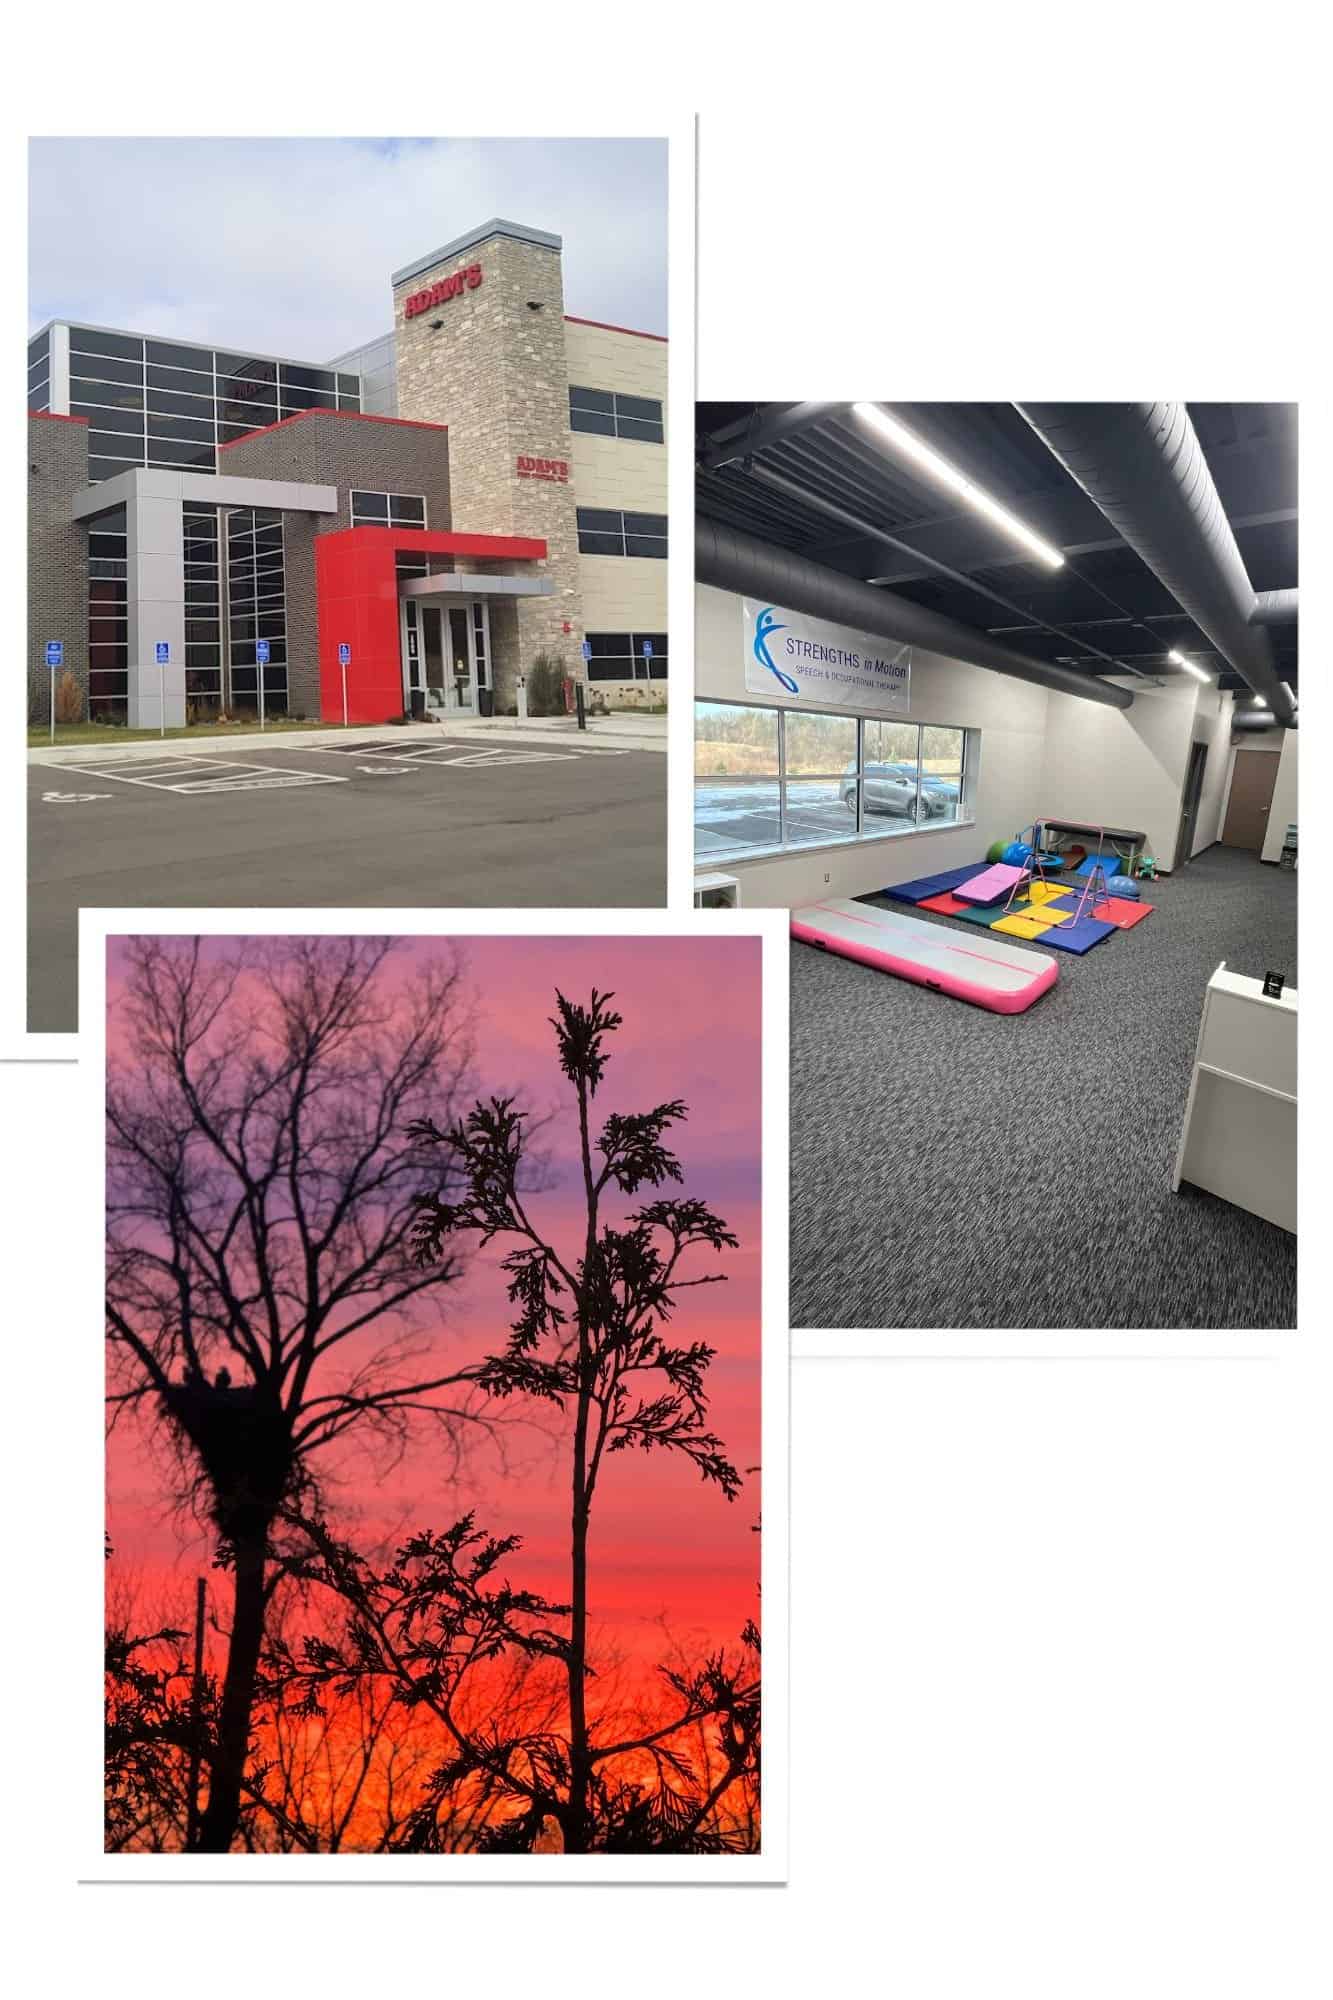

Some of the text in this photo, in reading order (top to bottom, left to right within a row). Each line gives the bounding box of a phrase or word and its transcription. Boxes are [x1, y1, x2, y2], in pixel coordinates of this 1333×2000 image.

[405, 263, 483, 319] ADAM'S
[517, 456, 568, 475] ADAM'S
[786, 638, 906, 678] STRENGTHS in Motion
[795, 665, 824, 678] SPEECH
[831, 671, 874, 688] OCCUPATIONAL
